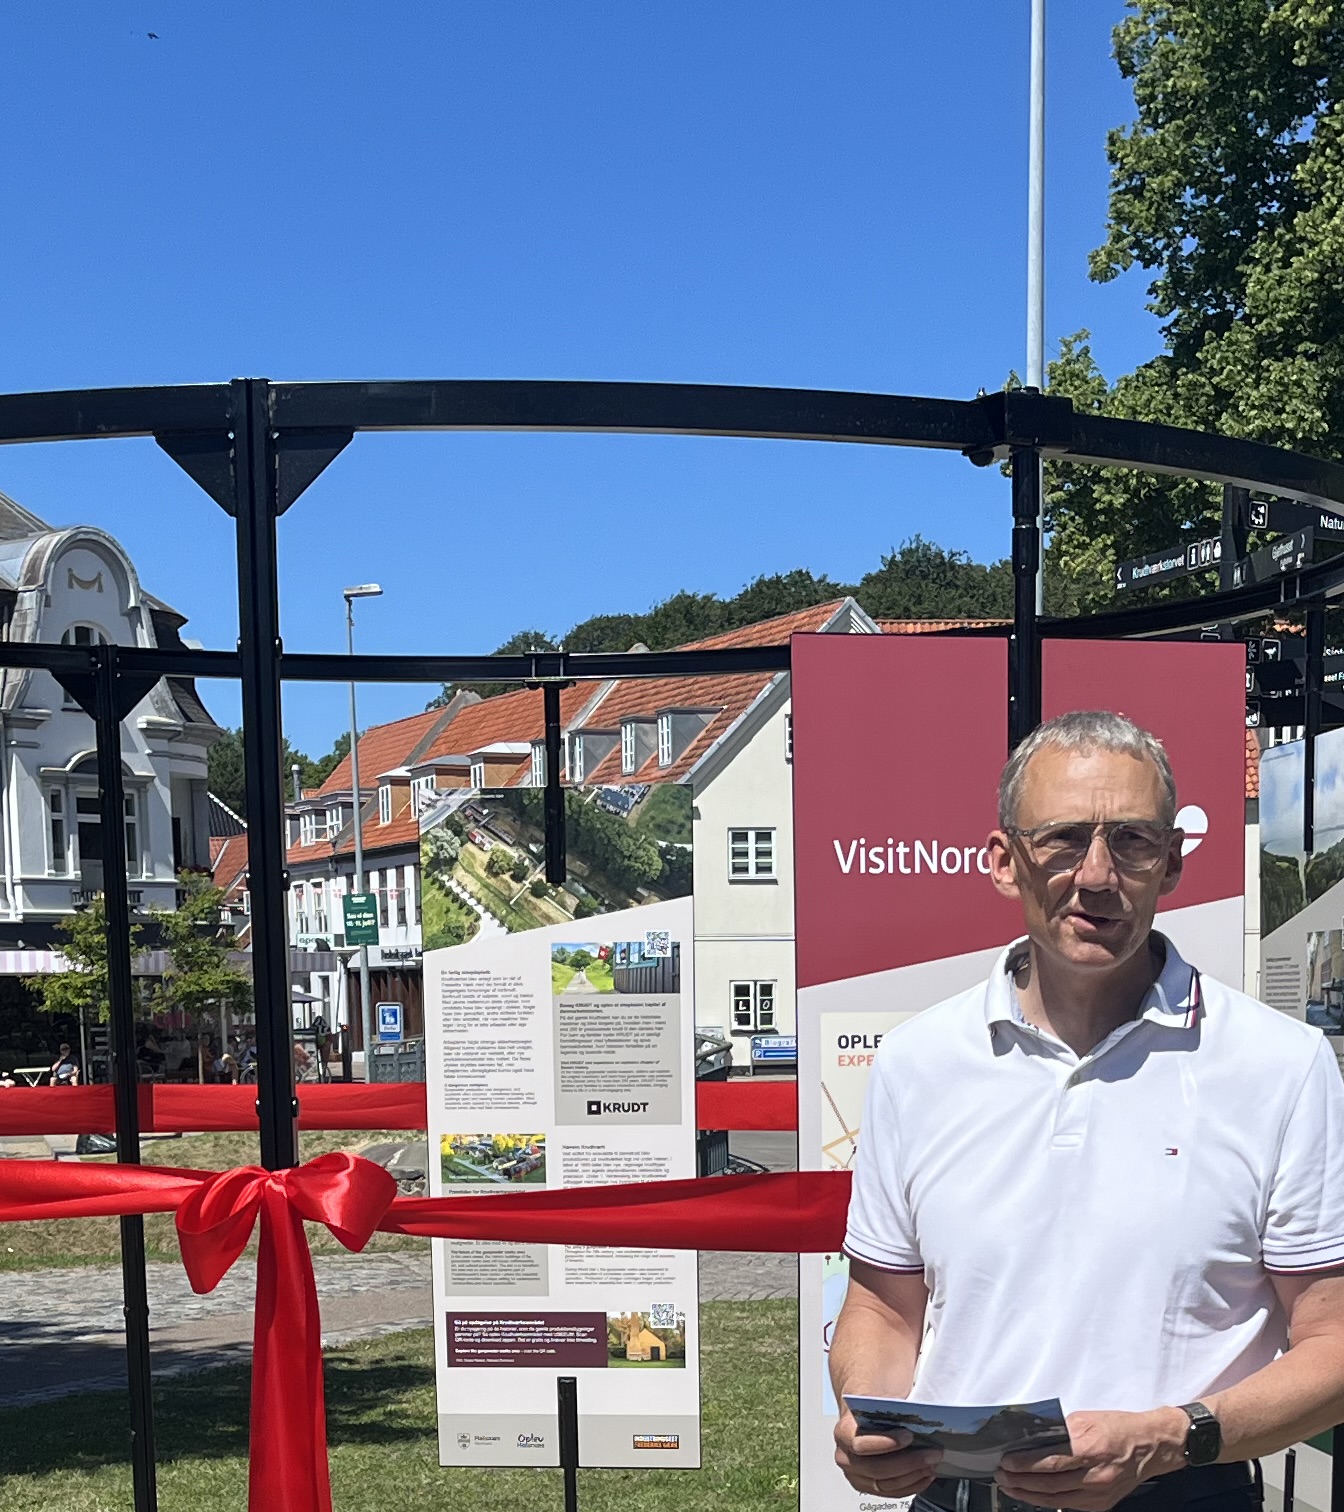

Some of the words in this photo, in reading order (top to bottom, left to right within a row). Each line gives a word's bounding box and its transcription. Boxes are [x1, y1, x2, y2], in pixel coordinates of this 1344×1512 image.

[838, 1055, 874, 1067] EXPE
[602, 1102, 649, 1113] KRUDT
[859, 1501, 898, 1512] Gågaden
